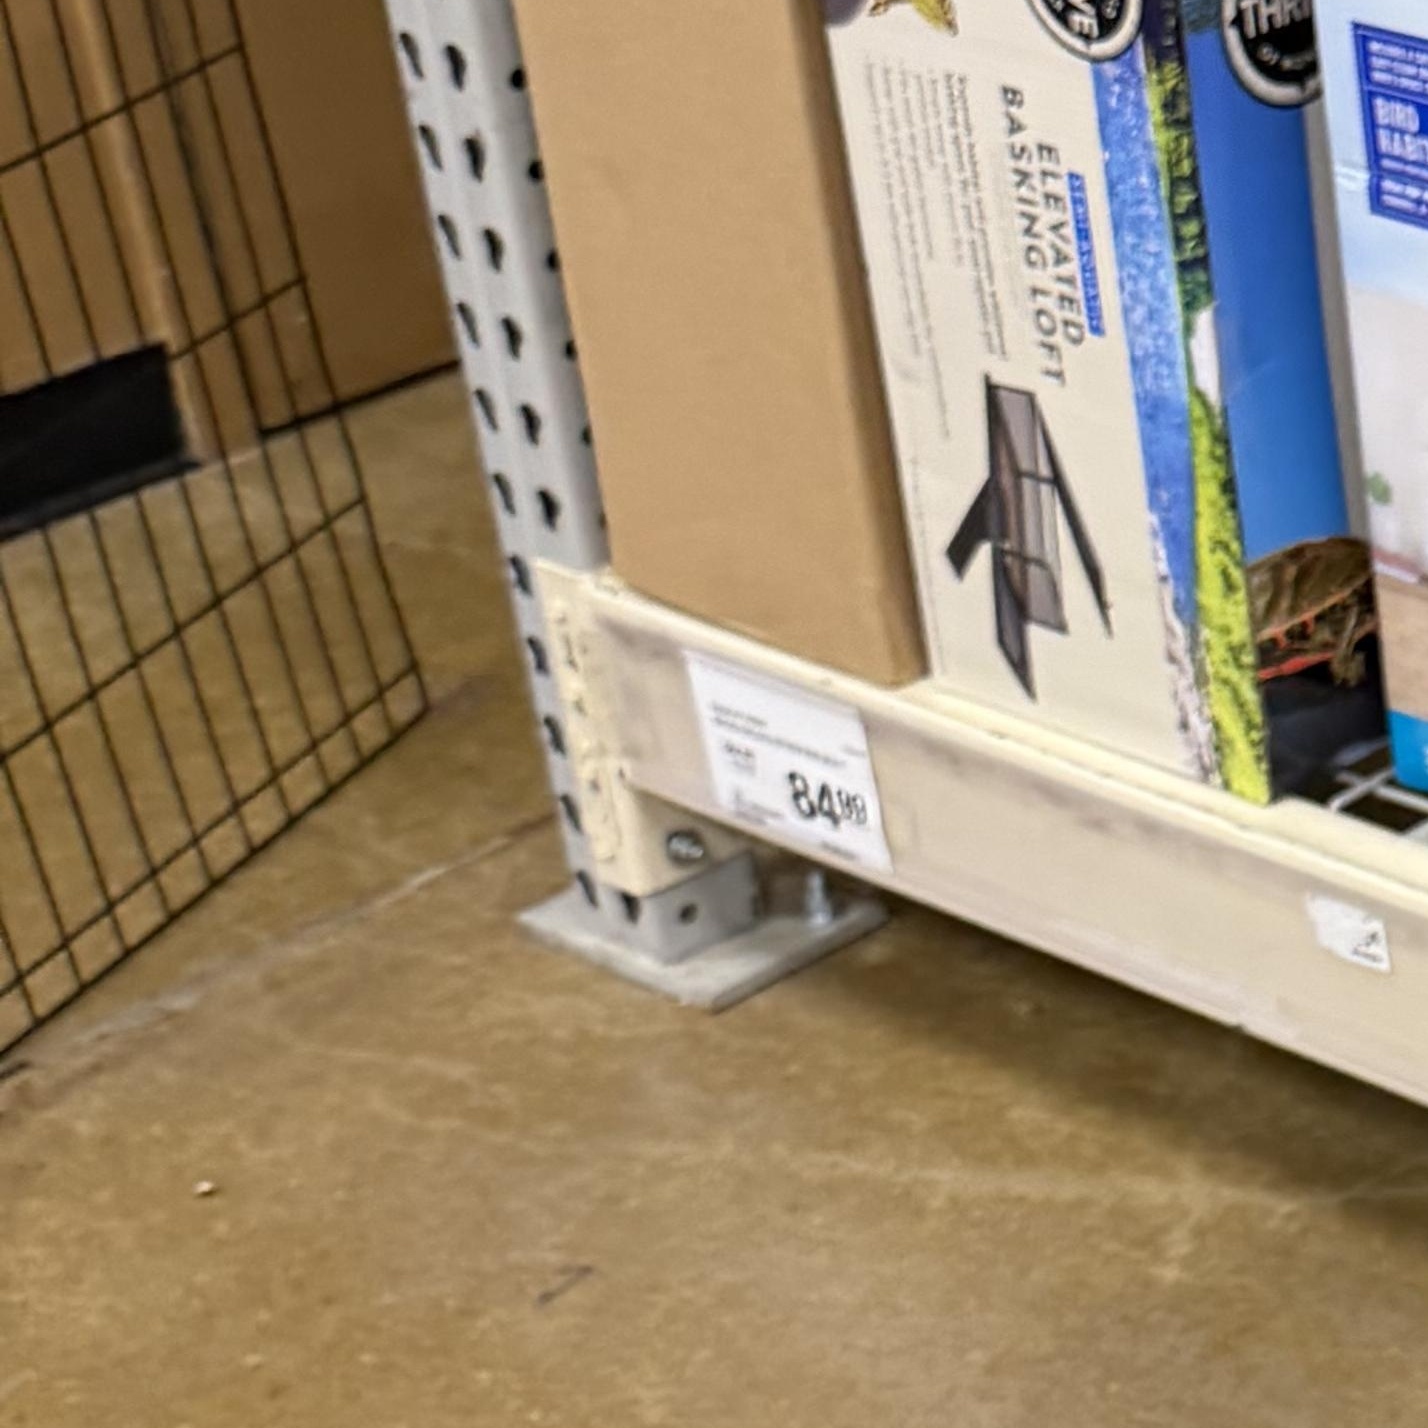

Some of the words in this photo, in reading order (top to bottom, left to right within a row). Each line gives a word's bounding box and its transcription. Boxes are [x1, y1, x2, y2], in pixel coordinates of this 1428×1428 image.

[1374, 95, 1419, 133] BIRD
[998, 84, 1048, 269] BASKING
[1030, 285, 1066, 387] LOFT
[1034, 141, 1087, 346] ELEVATED
